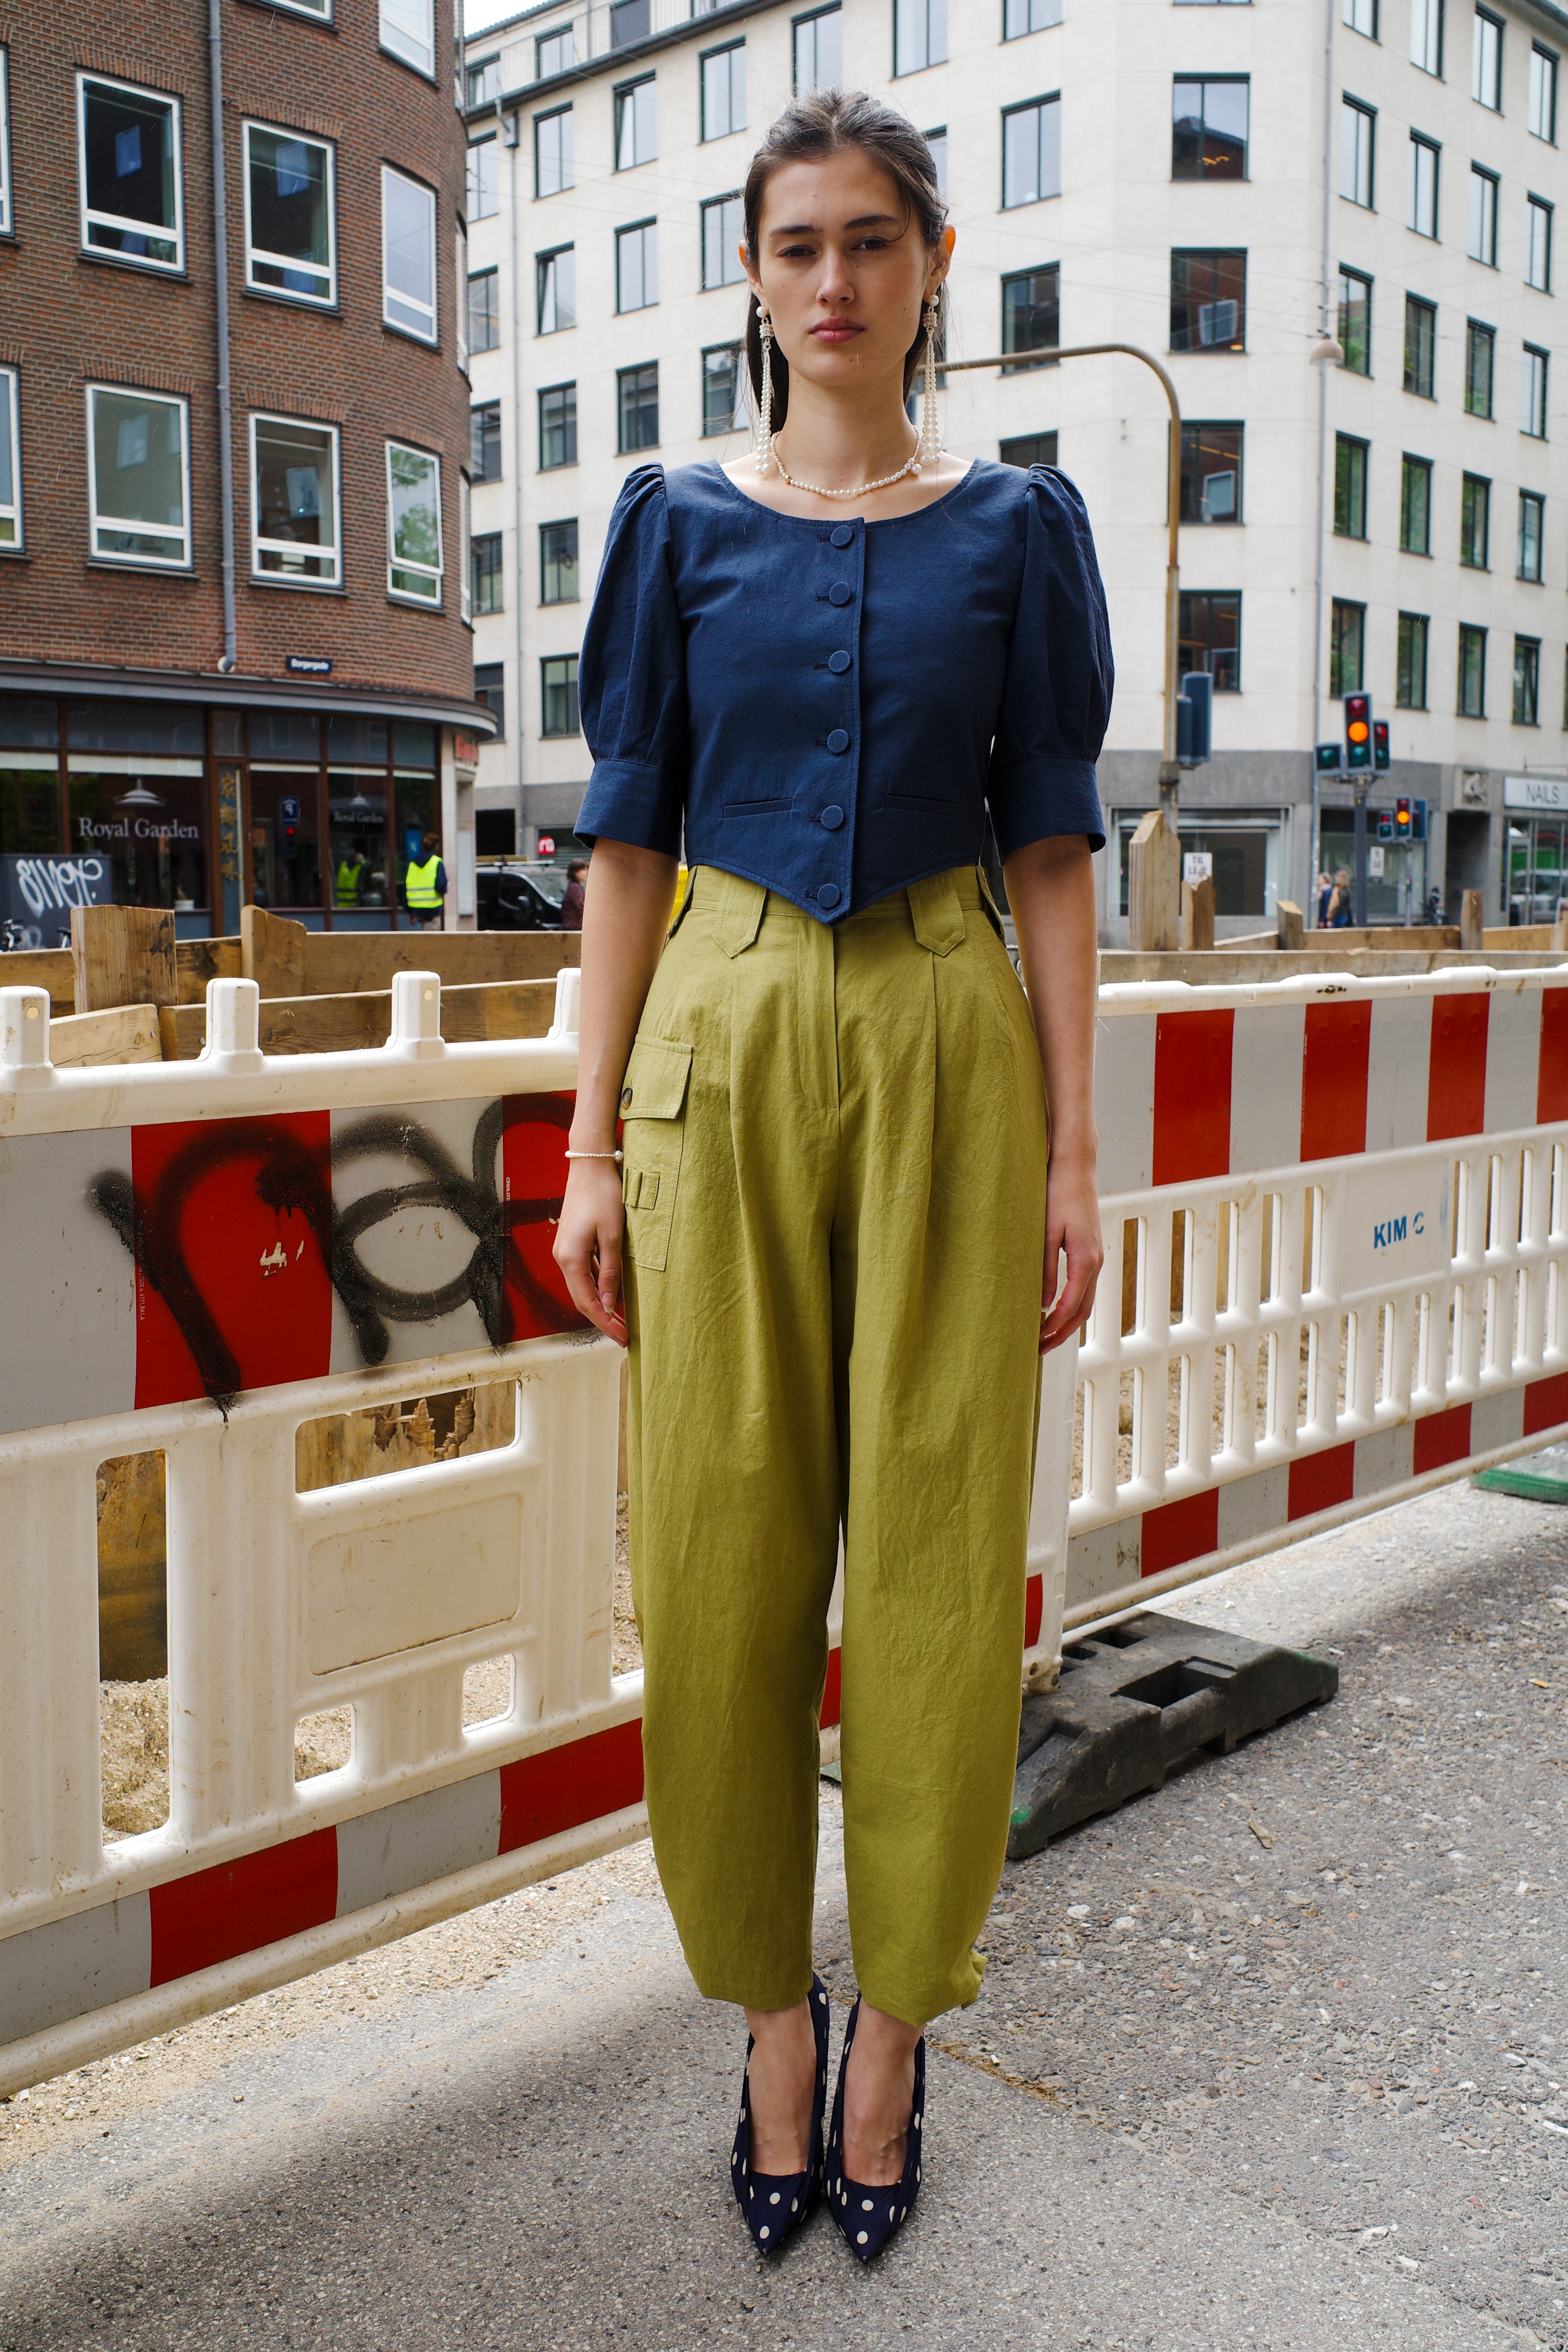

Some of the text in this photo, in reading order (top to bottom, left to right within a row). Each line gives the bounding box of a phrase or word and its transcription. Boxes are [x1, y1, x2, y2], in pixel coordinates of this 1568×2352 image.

[1526, 784, 1560, 805] NAILS
[78, 817, 199, 841] Royal Garden
[1374, 1215, 1407, 1249] KIM
